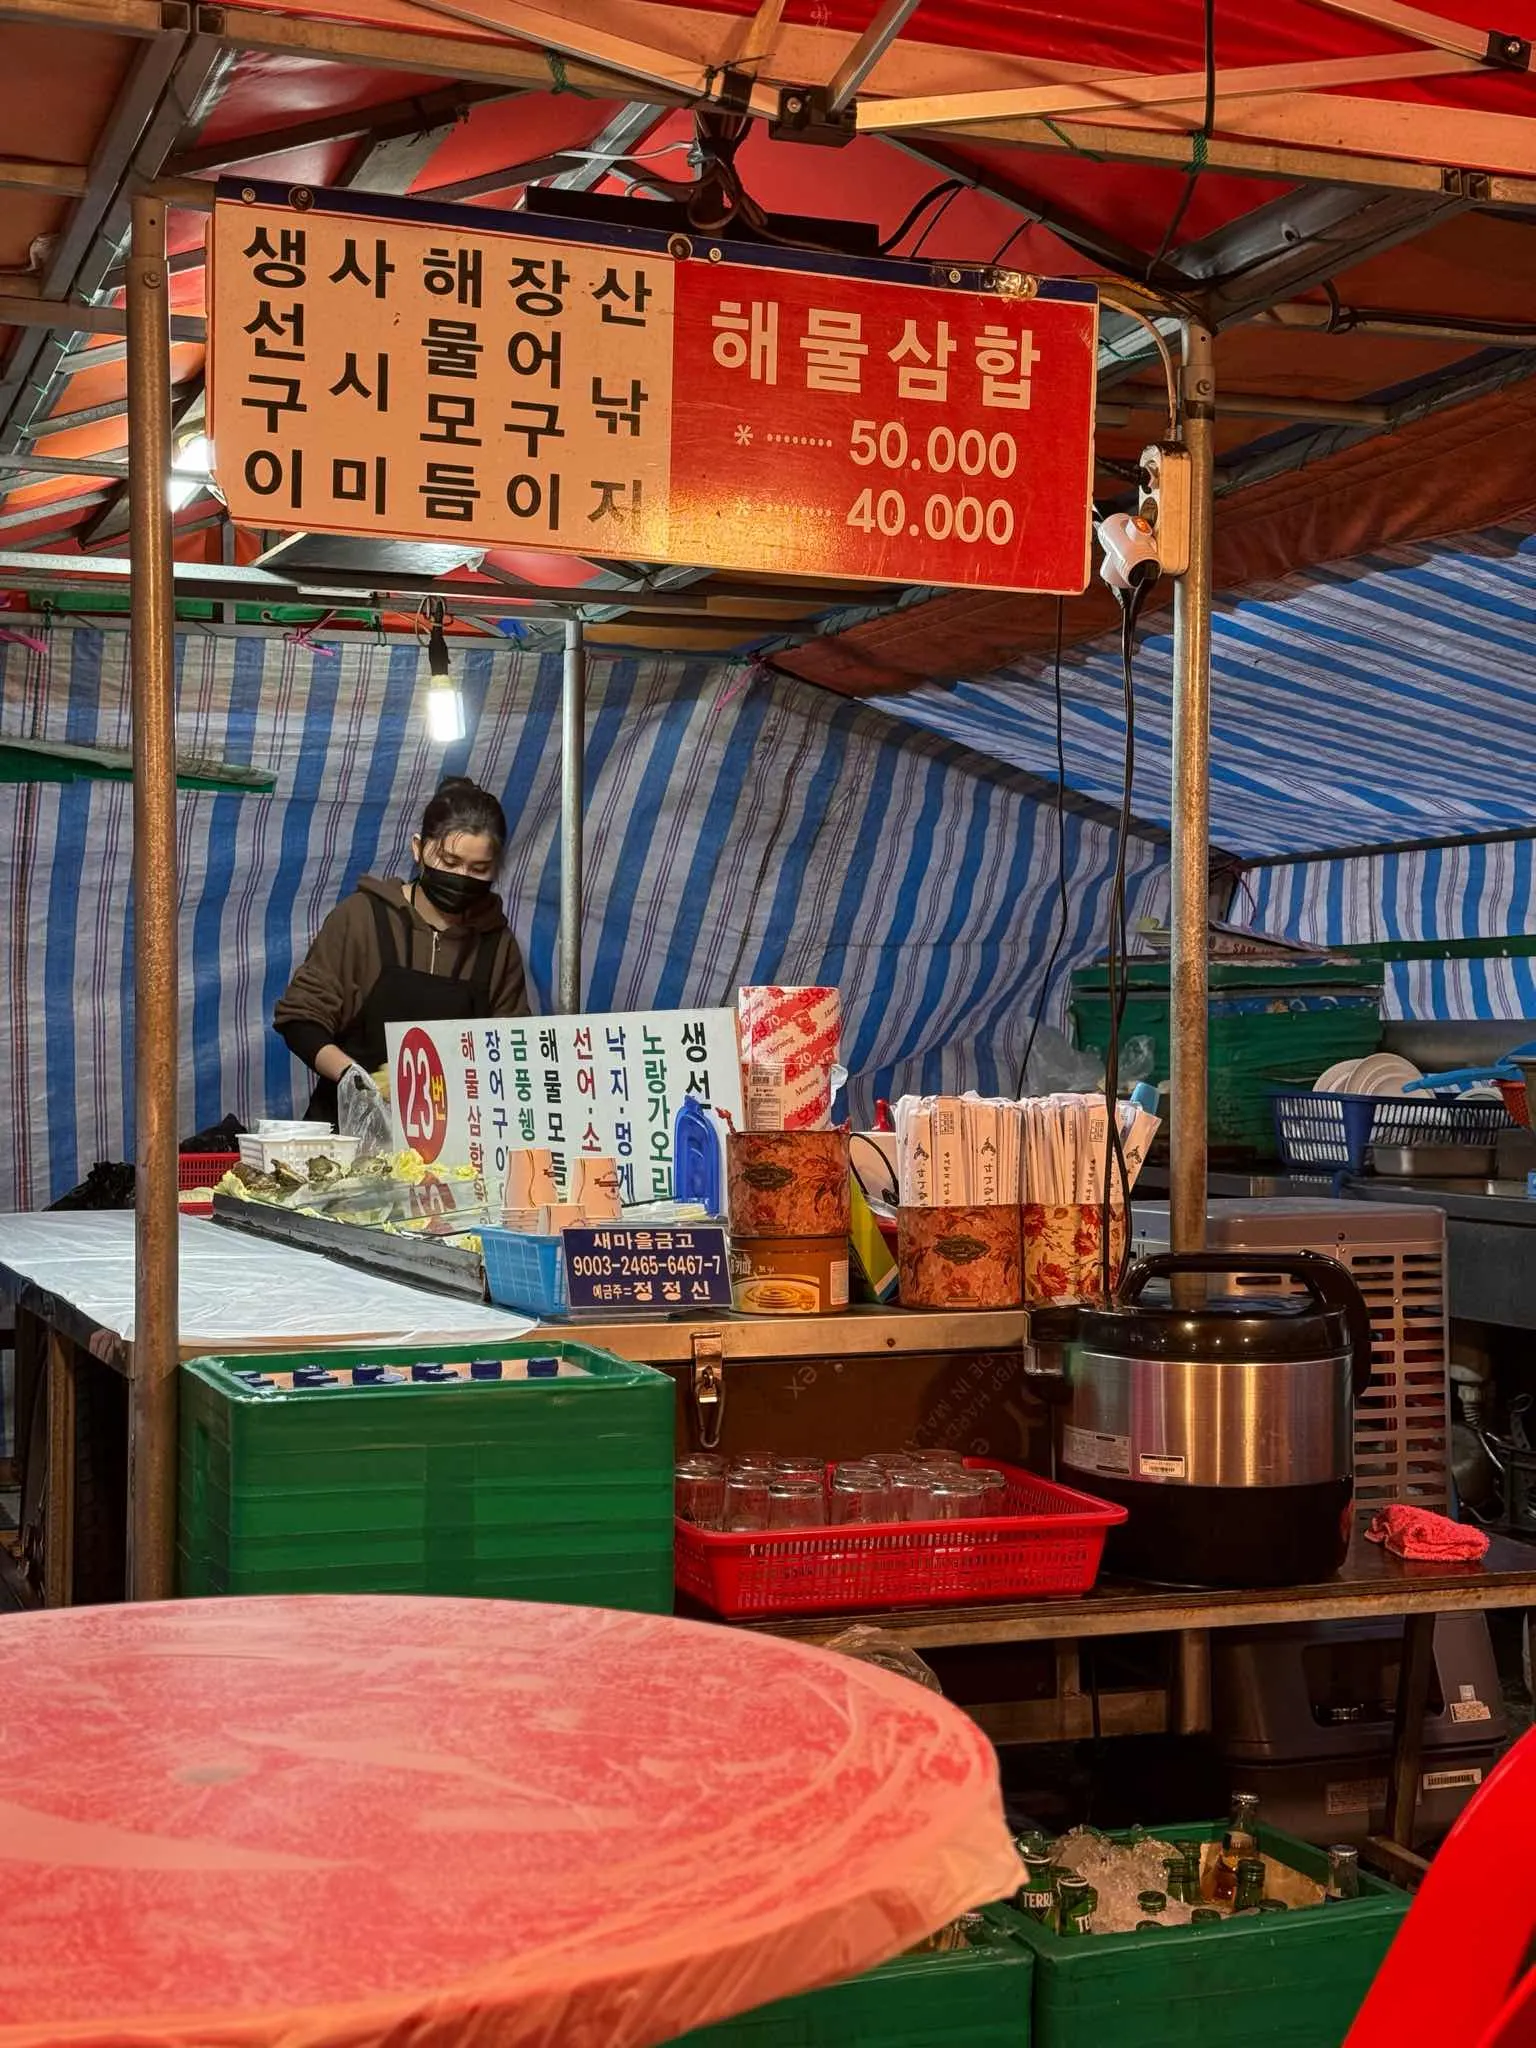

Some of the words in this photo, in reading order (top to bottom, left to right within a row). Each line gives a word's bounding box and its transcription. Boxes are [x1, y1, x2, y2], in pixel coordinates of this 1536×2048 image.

[242, 226, 307, 509] 생선구이
[328, 238, 395, 515] 사시미
[419, 247, 484, 522] 해물모듬
[504, 257, 570, 531] 장어구이
[587, 267, 653, 526] 산낚지
[711, 300, 1041, 410] 해물삼합
[846, 488, 1015, 546] 40.000
[849, 419, 1018, 479] 50.000
[642, 1025, 673, 1198] 노랑가오리
[573, 1255, 721, 1277] 9003-2465-6467-7
[593, 1231, 695, 1250] 새마을금고
